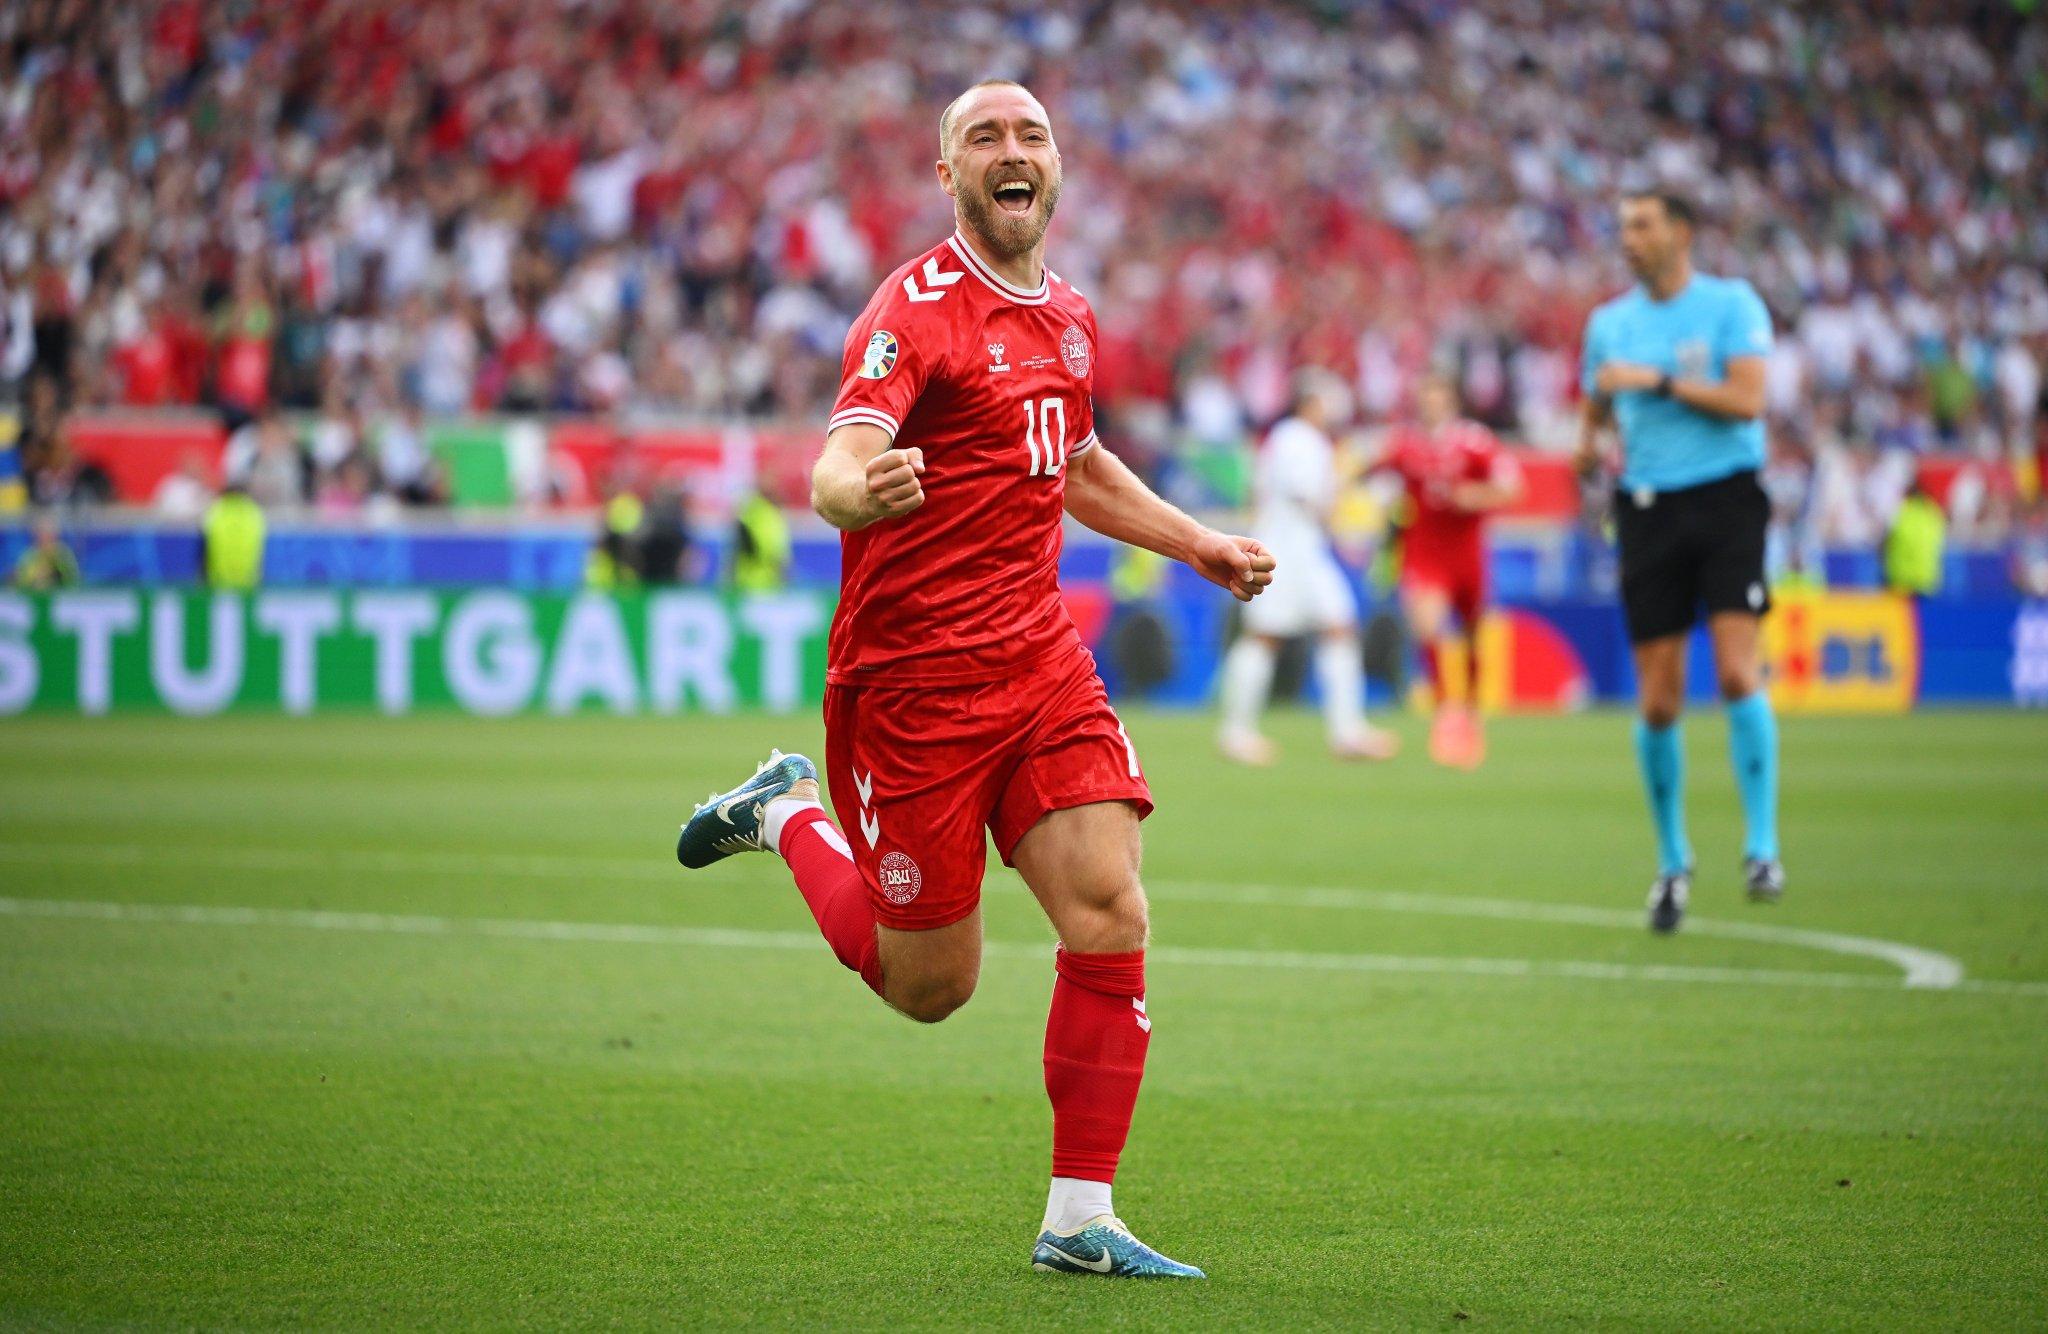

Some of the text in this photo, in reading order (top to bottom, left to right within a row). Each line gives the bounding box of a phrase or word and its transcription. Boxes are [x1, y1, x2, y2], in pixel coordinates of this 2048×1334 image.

[1068, 342, 1086, 359] DBU
[1023, 397, 1066, 475] 10
[0, 590, 829, 715] STUTTGART
[886, 869, 911, 885] DBU
